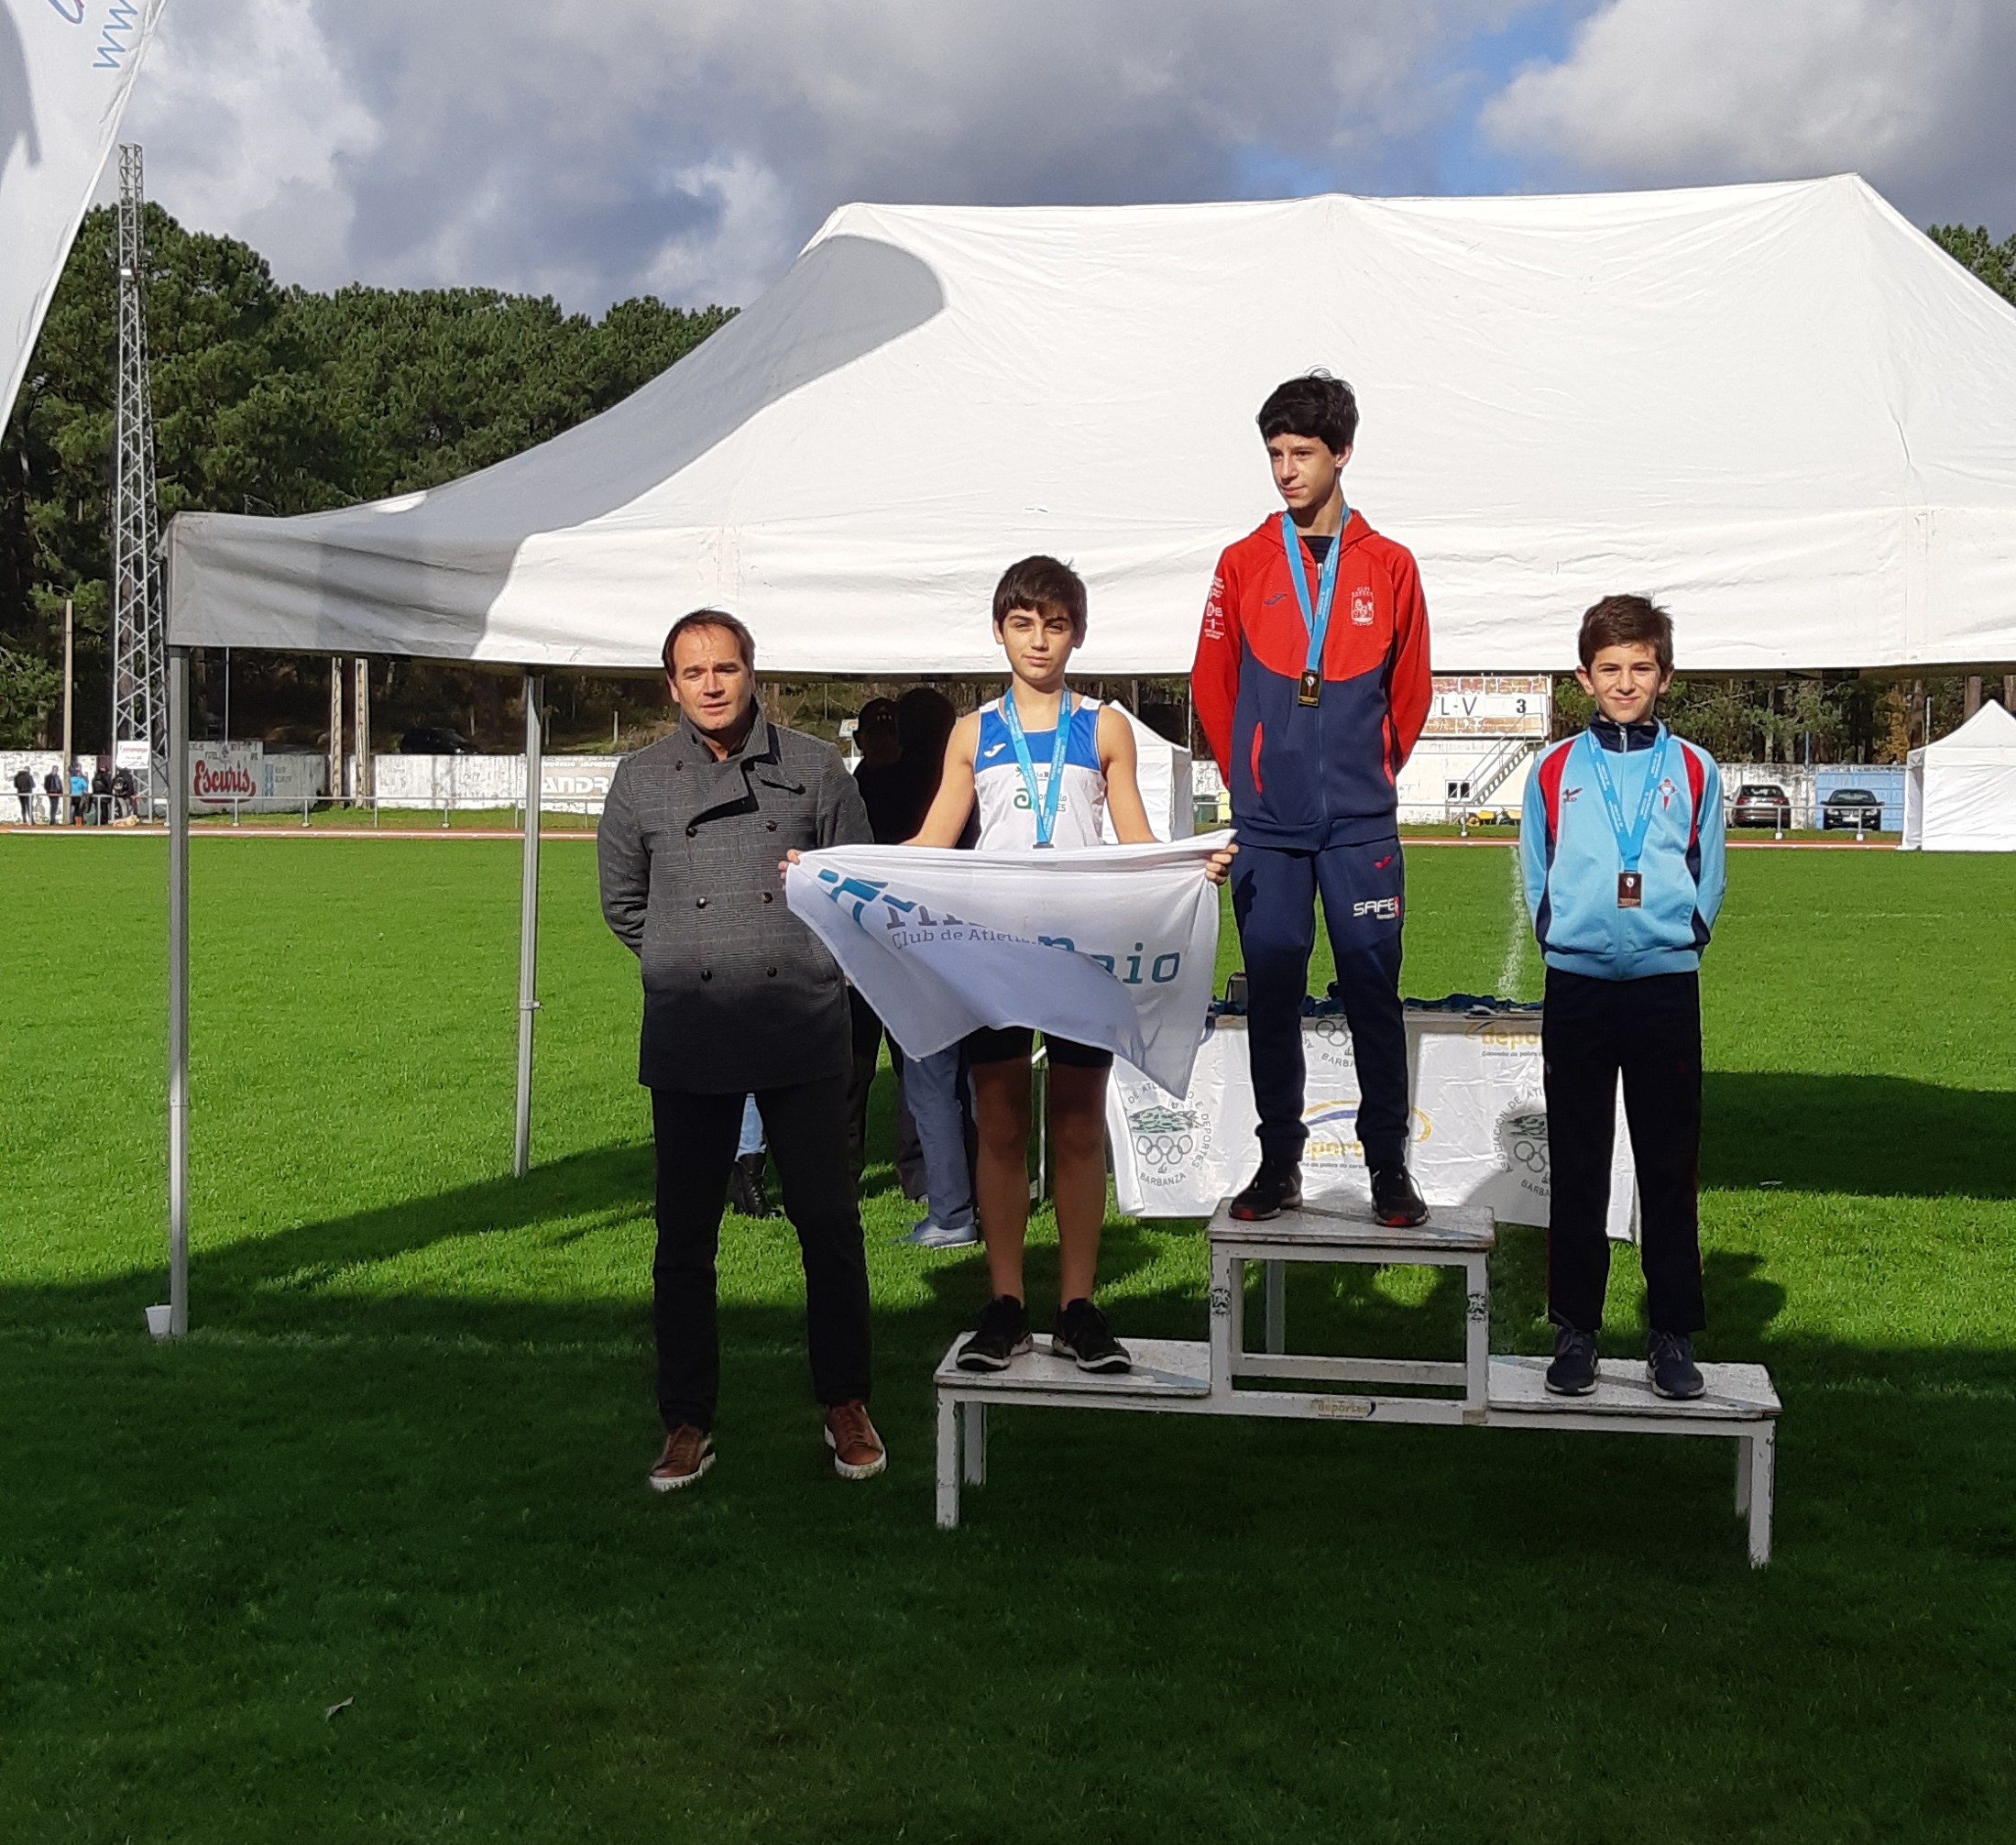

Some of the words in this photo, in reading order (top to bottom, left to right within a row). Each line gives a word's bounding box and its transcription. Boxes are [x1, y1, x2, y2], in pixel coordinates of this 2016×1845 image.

[1516, 698, 1527, 714] 3
[193, 759, 257, 803] Escuris
[542, 776, 611, 795] ANDR
[892, 929, 935, 950] Club
[941, 929, 963, 941] de
[1481, 1026, 1539, 1050] depo
[1128, 1091, 1140, 1104] DE
[1507, 1095, 1522, 1109] DE
[1192, 1113, 1211, 1171] DEPORTES
[1140, 1171, 1186, 1187] BARBANZA
[1521, 1179, 1550, 1197] BARBA
